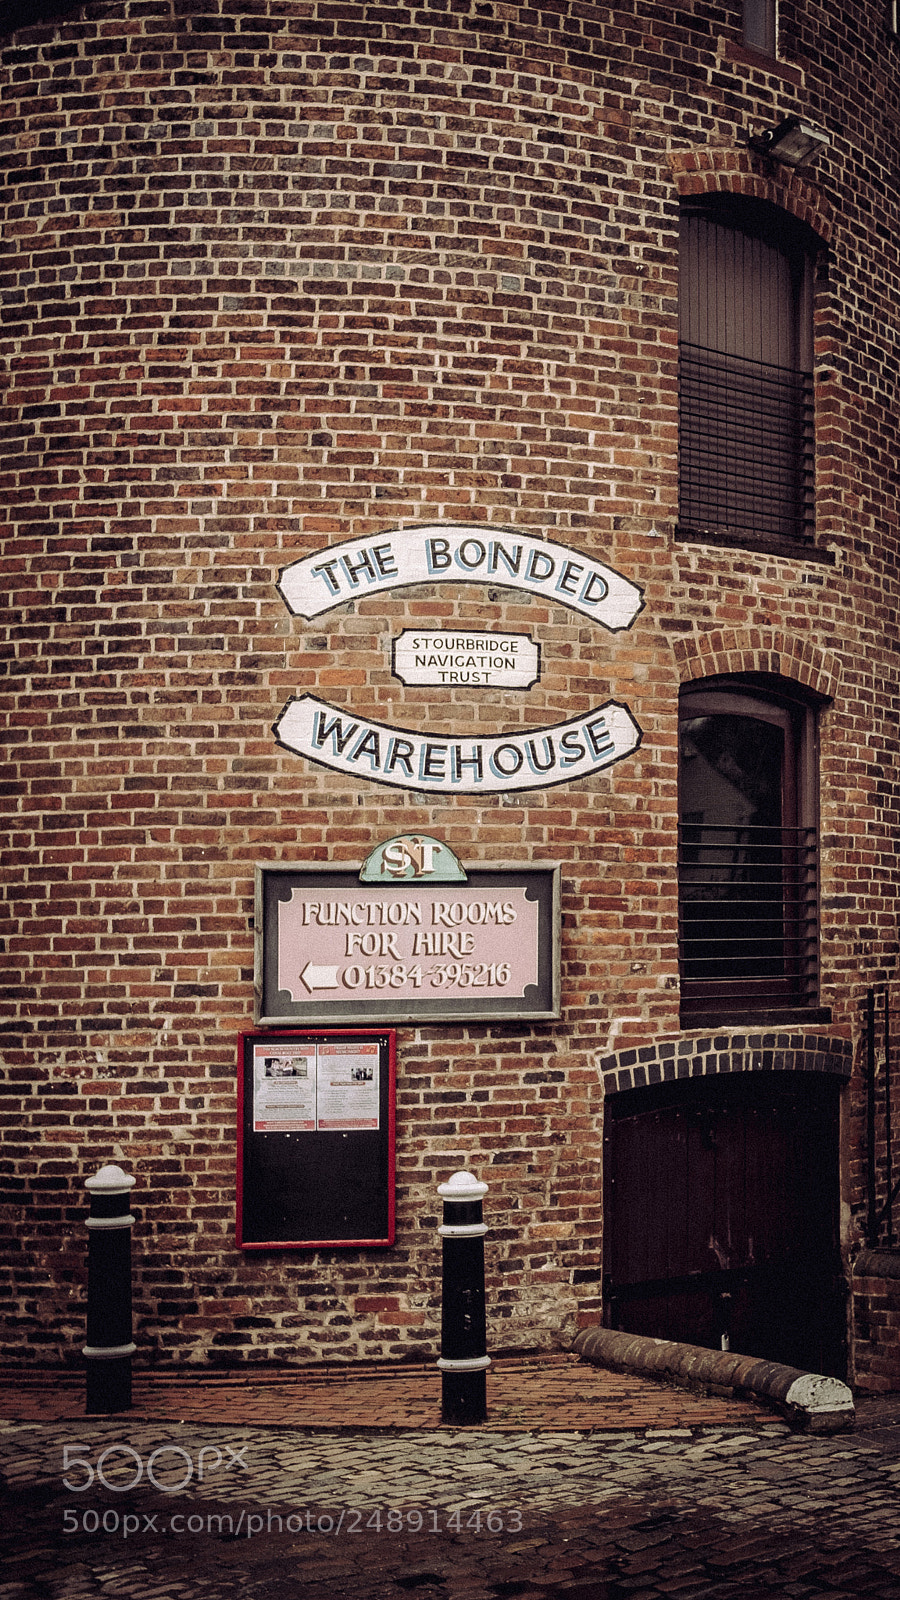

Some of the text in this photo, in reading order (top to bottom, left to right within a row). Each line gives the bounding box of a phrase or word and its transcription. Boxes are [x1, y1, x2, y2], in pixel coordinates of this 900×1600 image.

[311, 538, 609, 606] THE BONDED
[412, 637, 518, 653] STOURBRIDGE
[415, 655, 516, 669] NAVIGATION
[438, 670, 492, 684] TRUST
[311, 711, 616, 783] WAREHOUSE
[302, 901, 518, 927] FUNCTION ROOMS
[345, 931, 476, 960] FOR HIRE
[342, 962, 512, 989] 01384-395216
